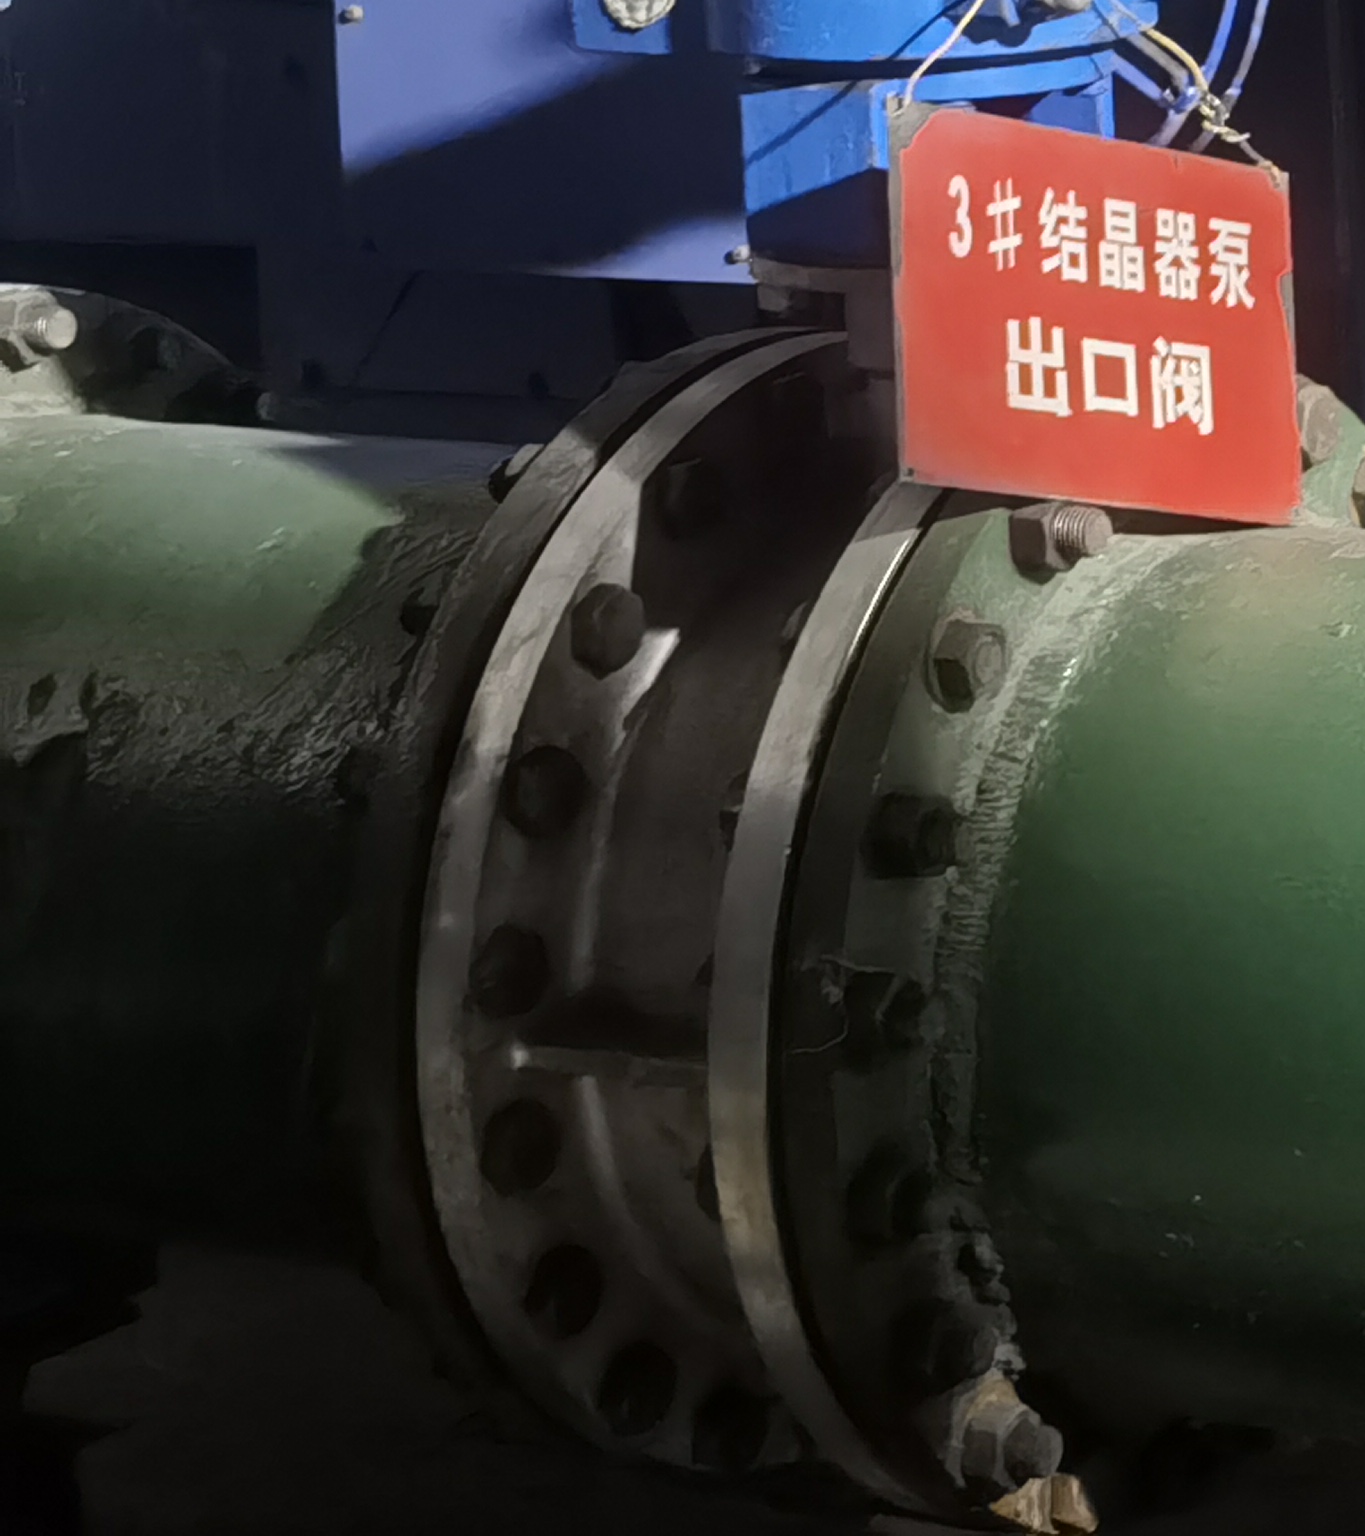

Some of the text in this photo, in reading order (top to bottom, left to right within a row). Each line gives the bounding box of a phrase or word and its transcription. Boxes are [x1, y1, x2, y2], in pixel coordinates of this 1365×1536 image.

[947, 175, 1255, 309] 3#结晶器泵
[1005, 317, 1214, 435] 出口阀
